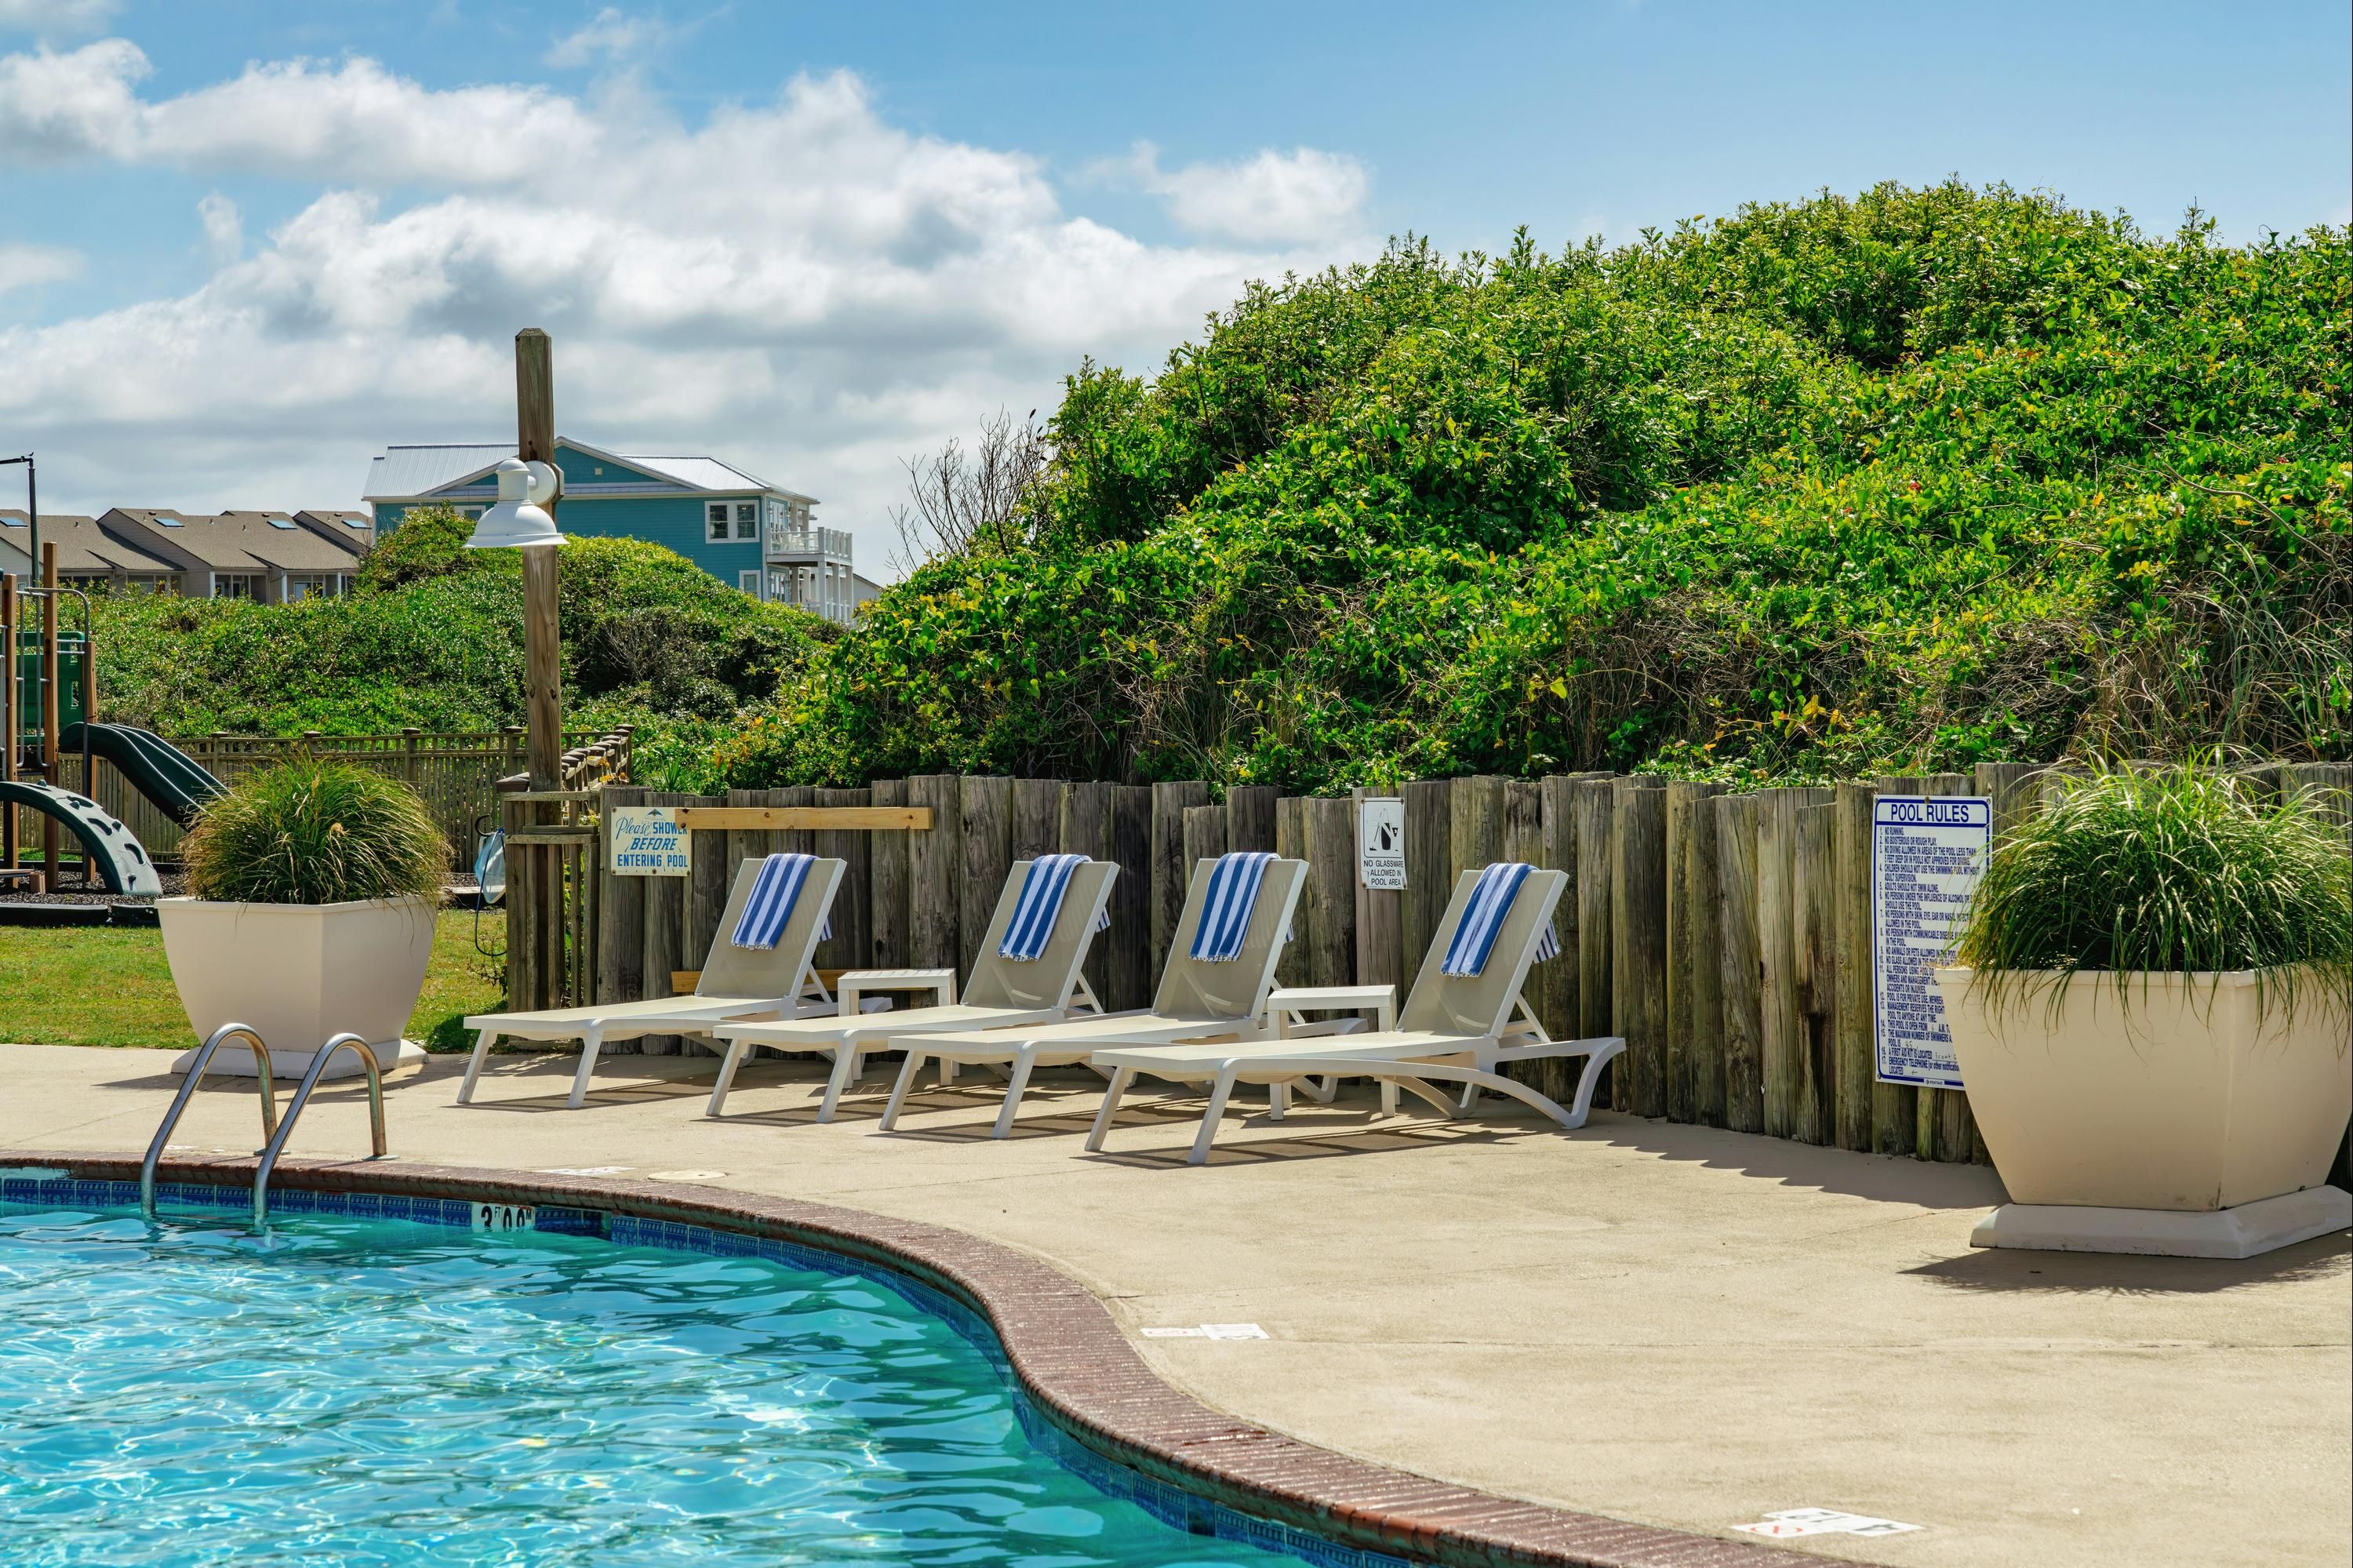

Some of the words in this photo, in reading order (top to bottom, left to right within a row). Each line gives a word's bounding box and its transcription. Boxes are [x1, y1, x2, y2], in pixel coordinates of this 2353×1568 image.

[1891, 804, 1923, 821] POOL
[1926, 804, 1969, 822] RULES
[616, 816, 651, 840] Please
[630, 838, 678, 850] BEFORE
[617, 854, 662, 866] ENTERING
[667, 855, 687, 867] POOL
[1375, 860, 1404, 868] GLASSWARE
[494, 1206, 501, 1218] FT
[526, 1210, 531, 1220] M
